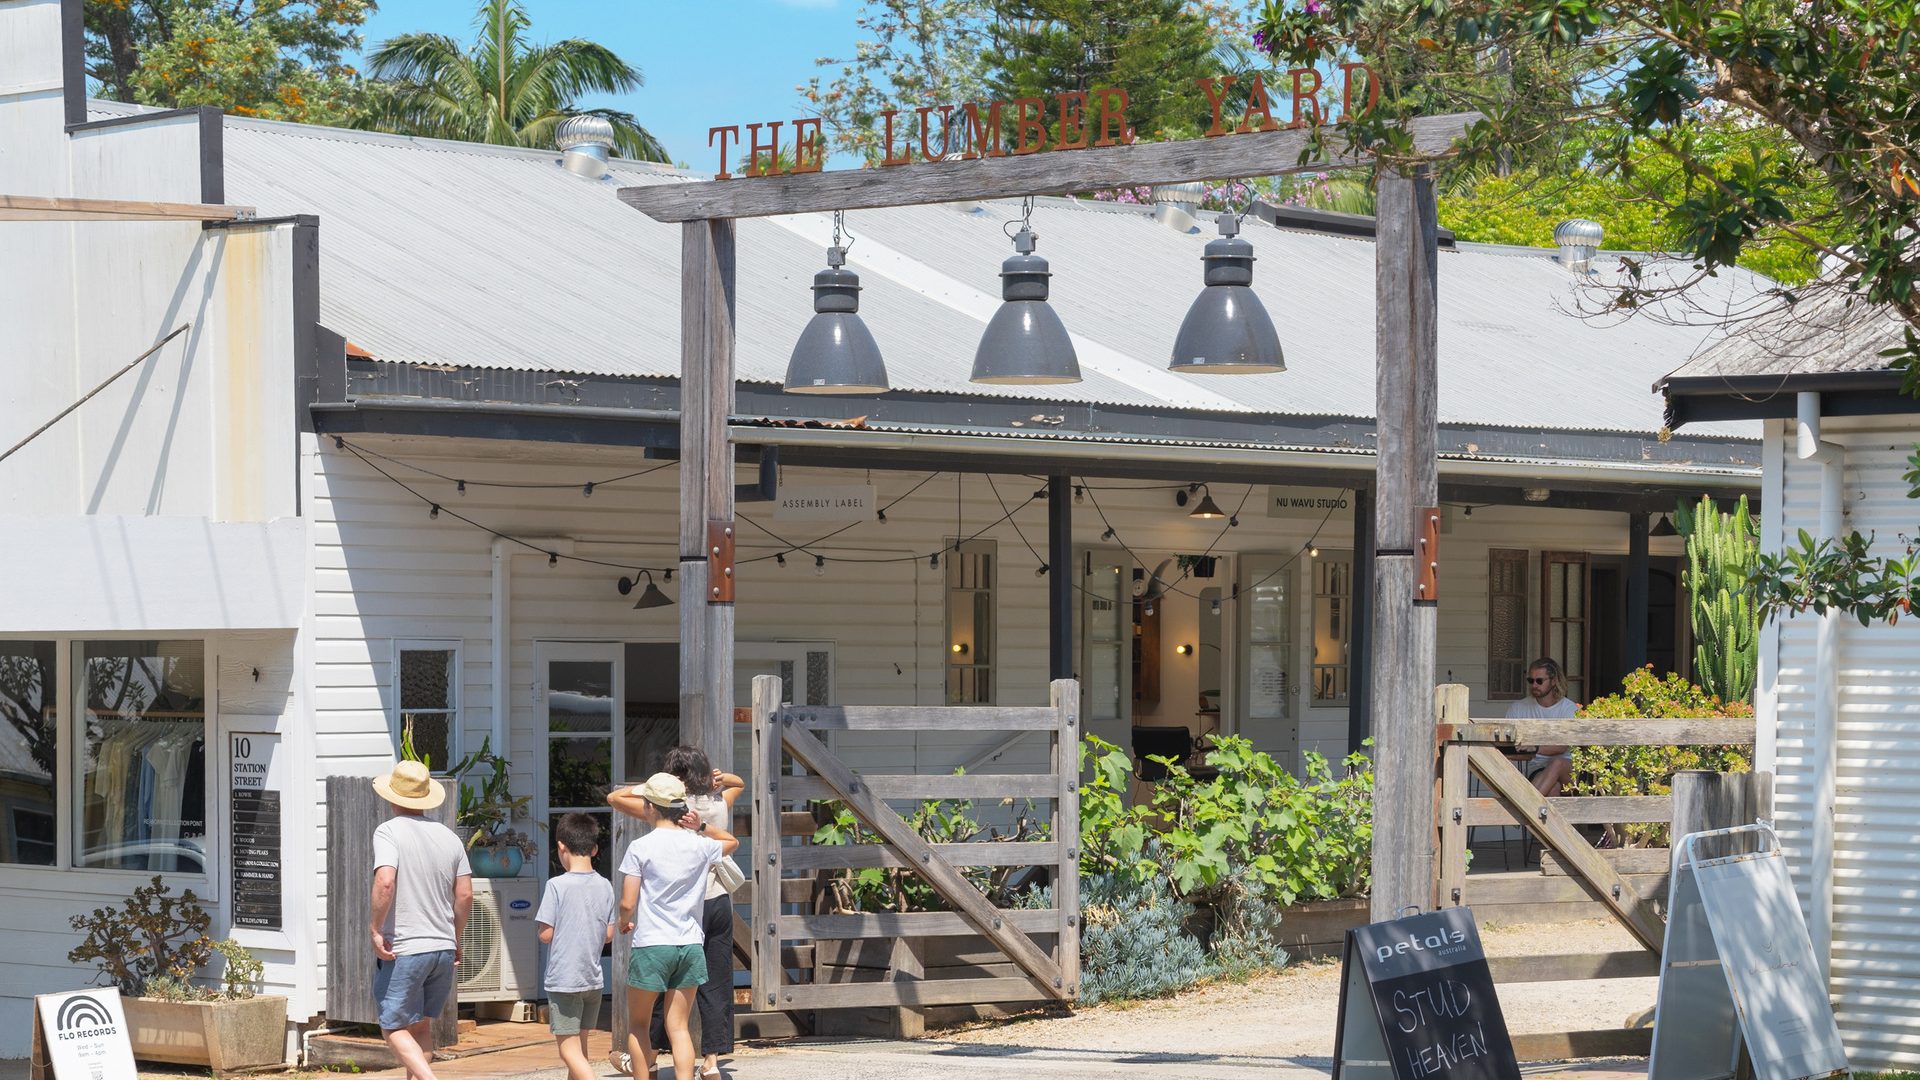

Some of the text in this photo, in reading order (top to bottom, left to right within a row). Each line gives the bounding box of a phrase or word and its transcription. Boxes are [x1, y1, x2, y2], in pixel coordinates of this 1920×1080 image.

[708, 62, 1380, 181] THE LUMBER YARD
[782, 498, 864, 509] ASSEMBLY LABEL
[1276, 497, 1348, 509] NU WAVU STUDIO
[234, 737, 251, 759] 10
[233, 762, 267, 774] STATION
[234, 776, 263, 787] STREET
[1376, 927, 1466, 963] petals
[1438, 944, 1467, 956] australia
[1393, 979, 1471, 1032] STUD
[58, 1026, 117, 1041] FLO RECORDS
[1405, 1021, 1488, 1080] HEAVEN
